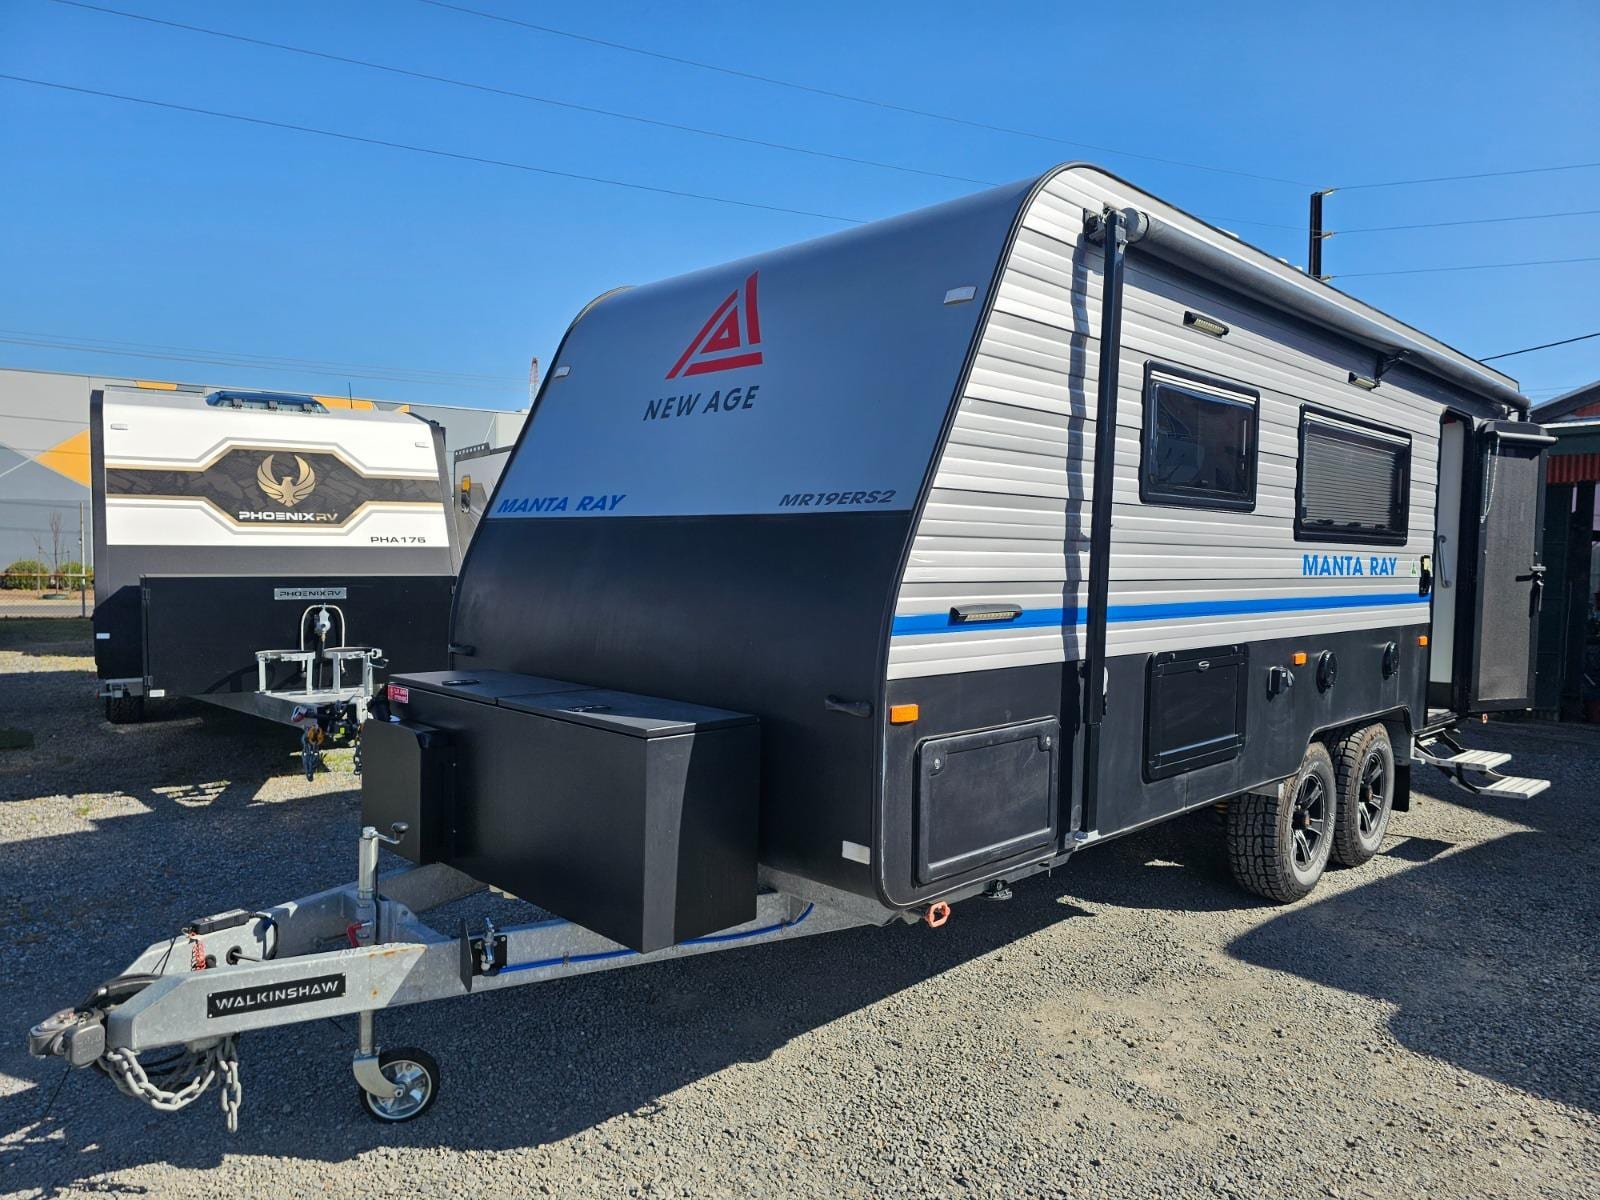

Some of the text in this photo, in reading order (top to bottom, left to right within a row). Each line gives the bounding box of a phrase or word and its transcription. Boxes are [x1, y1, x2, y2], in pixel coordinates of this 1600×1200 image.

[643, 385, 760, 421] NEW AGE
[497, 494, 627, 513] MANTA RAY
[778, 489, 897, 507] MR19ERS2
[1302, 554, 1398, 576] MANTA RAY
[215, 980, 339, 1010] WALKINSHAW
